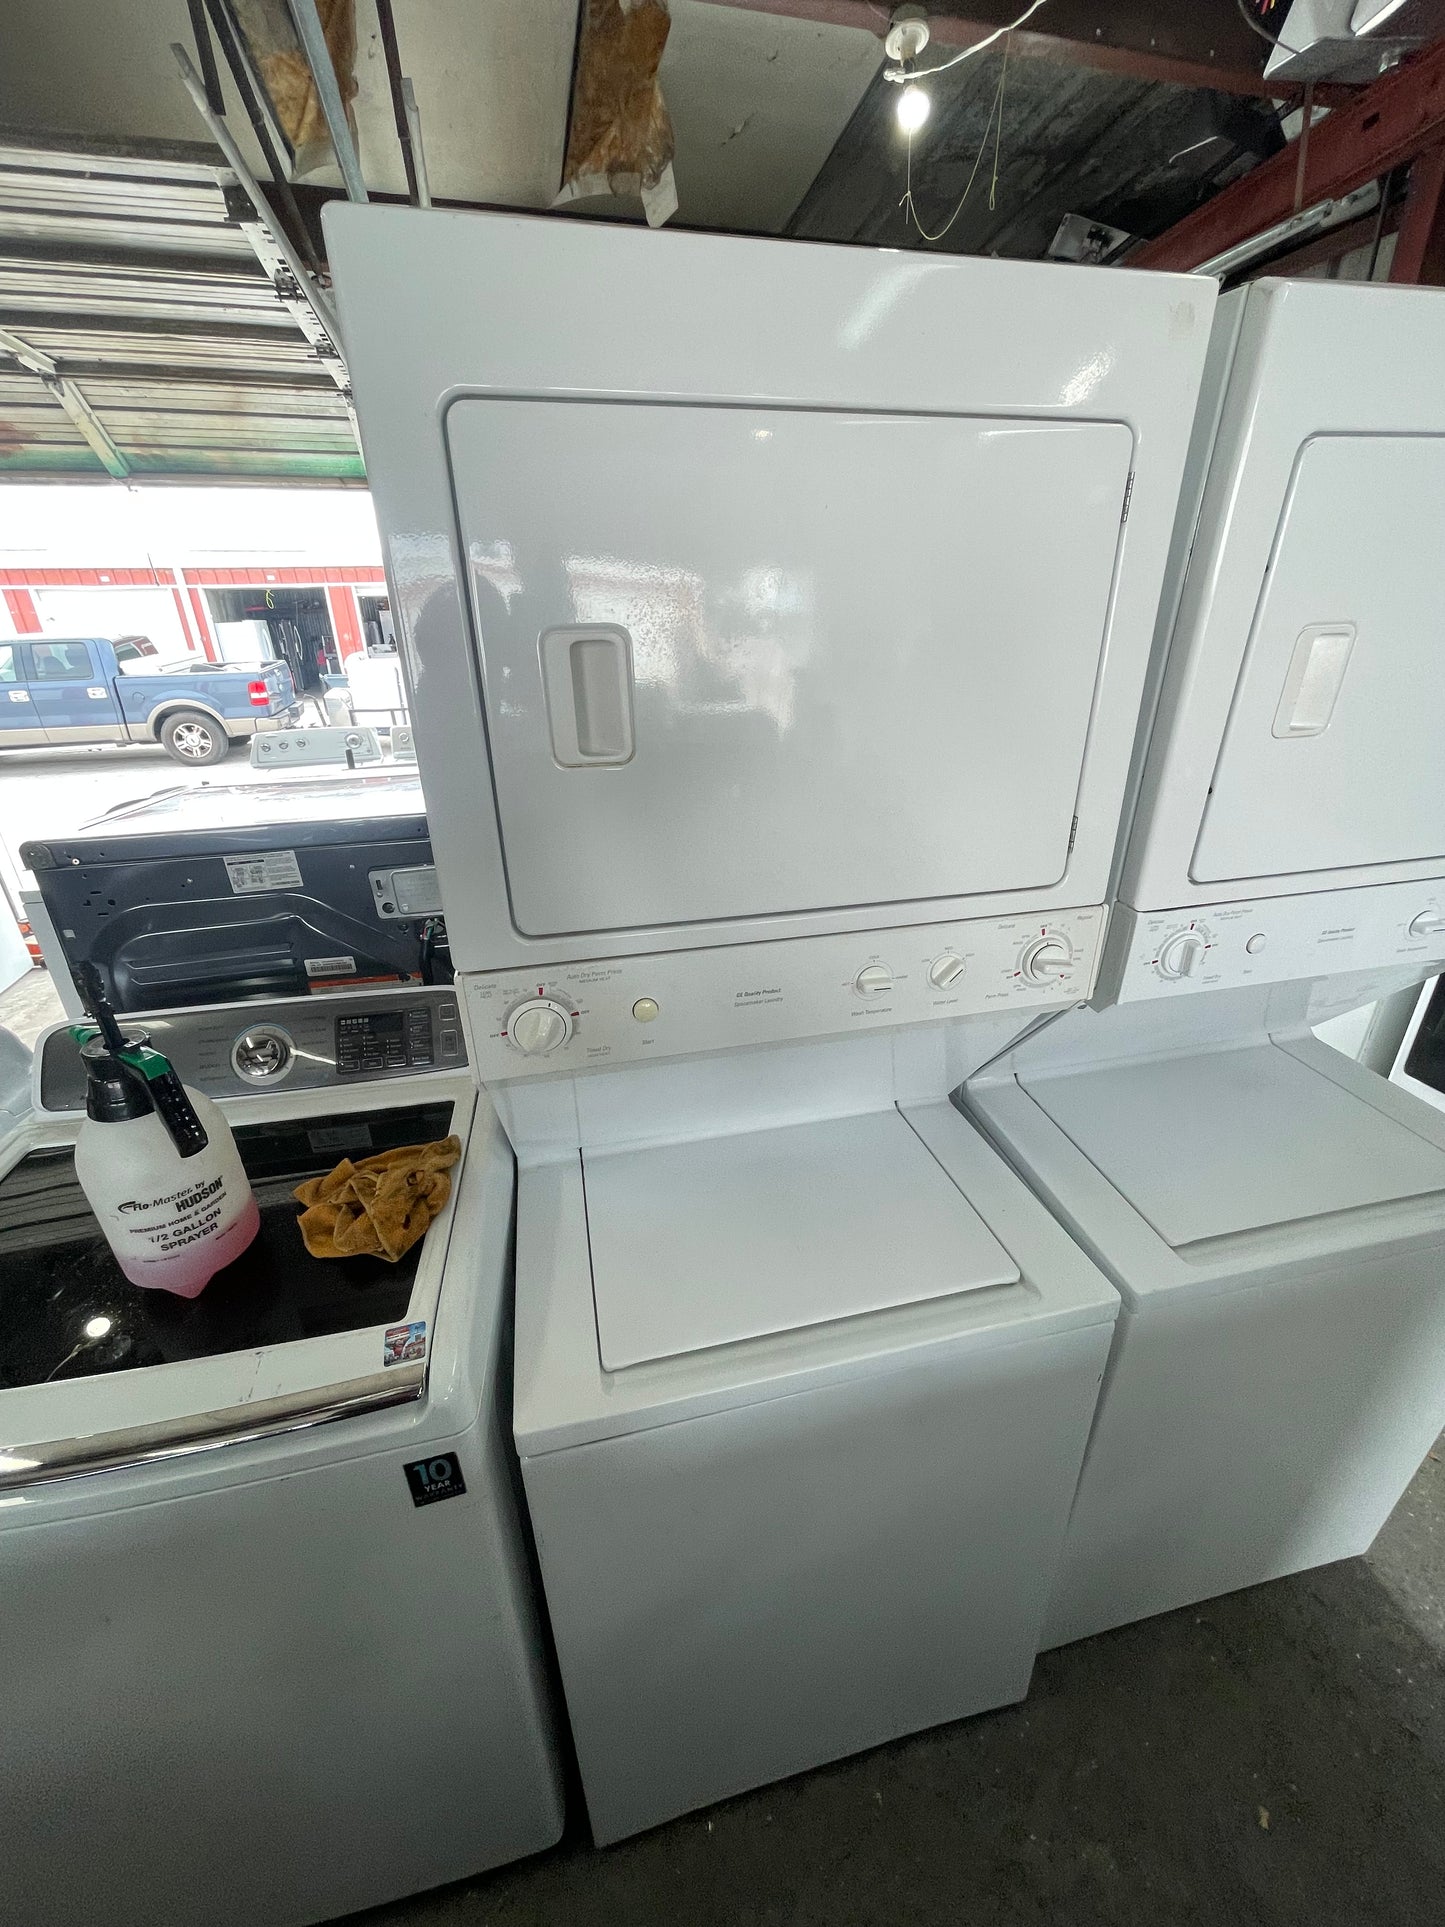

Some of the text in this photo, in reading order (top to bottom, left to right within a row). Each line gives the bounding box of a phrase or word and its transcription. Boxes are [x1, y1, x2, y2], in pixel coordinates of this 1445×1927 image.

[175, 1177, 223, 1212] HUDSON
[195, 1180, 205, 1190] by
[129, 1191, 227, 1234] PREMIUM HOME & GARDEN
[149, 1233, 170, 1243] 1/2
[173, 1207, 221, 1237] GALLON
[161, 1222, 218, 1251] SPRAYER
[412, 1458, 452, 1486] 10
[424, 1480, 451, 1492] YEAR
